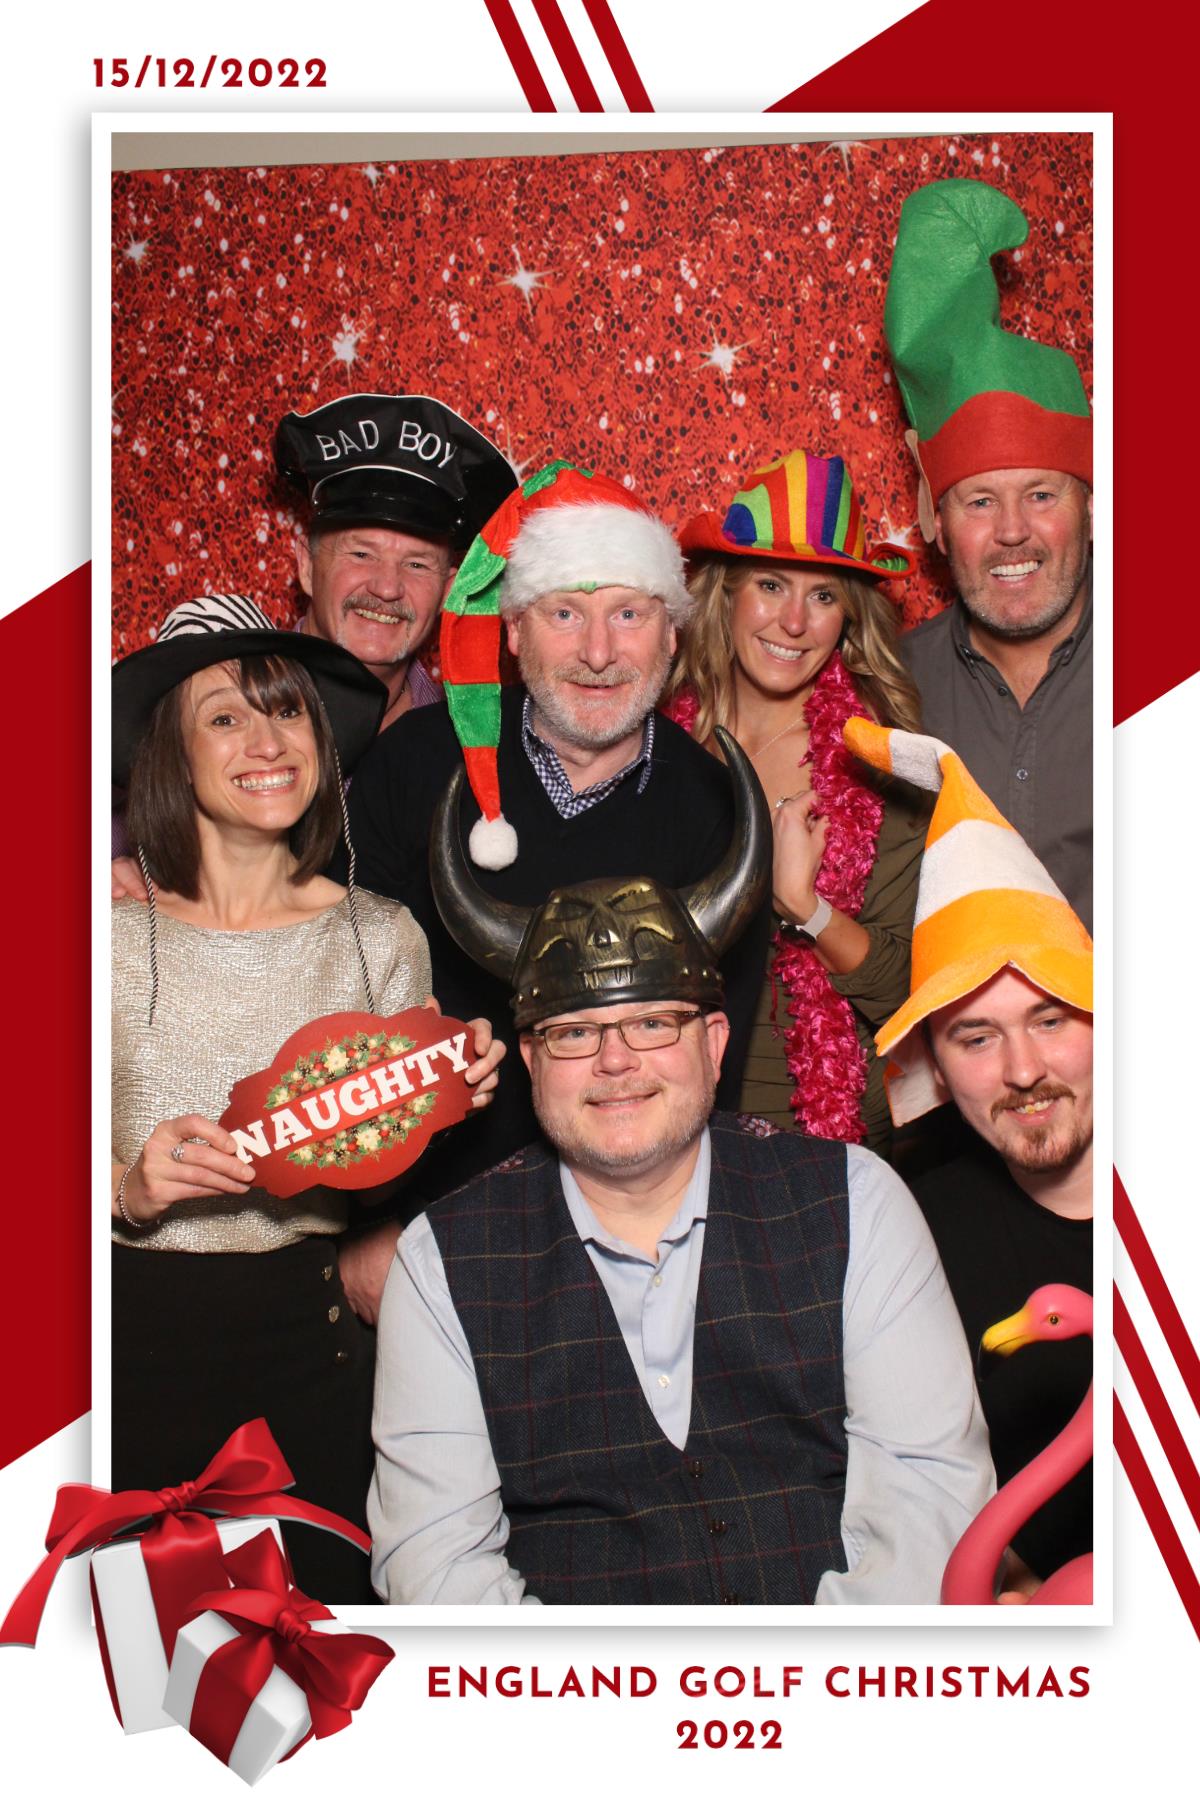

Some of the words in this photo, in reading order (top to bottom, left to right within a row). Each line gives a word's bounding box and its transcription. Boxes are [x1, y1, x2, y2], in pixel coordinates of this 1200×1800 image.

[316, 420, 379, 460] BAD
[399, 421, 456, 468] BOY
[229, 1033, 470, 1164] NAUGHTY
